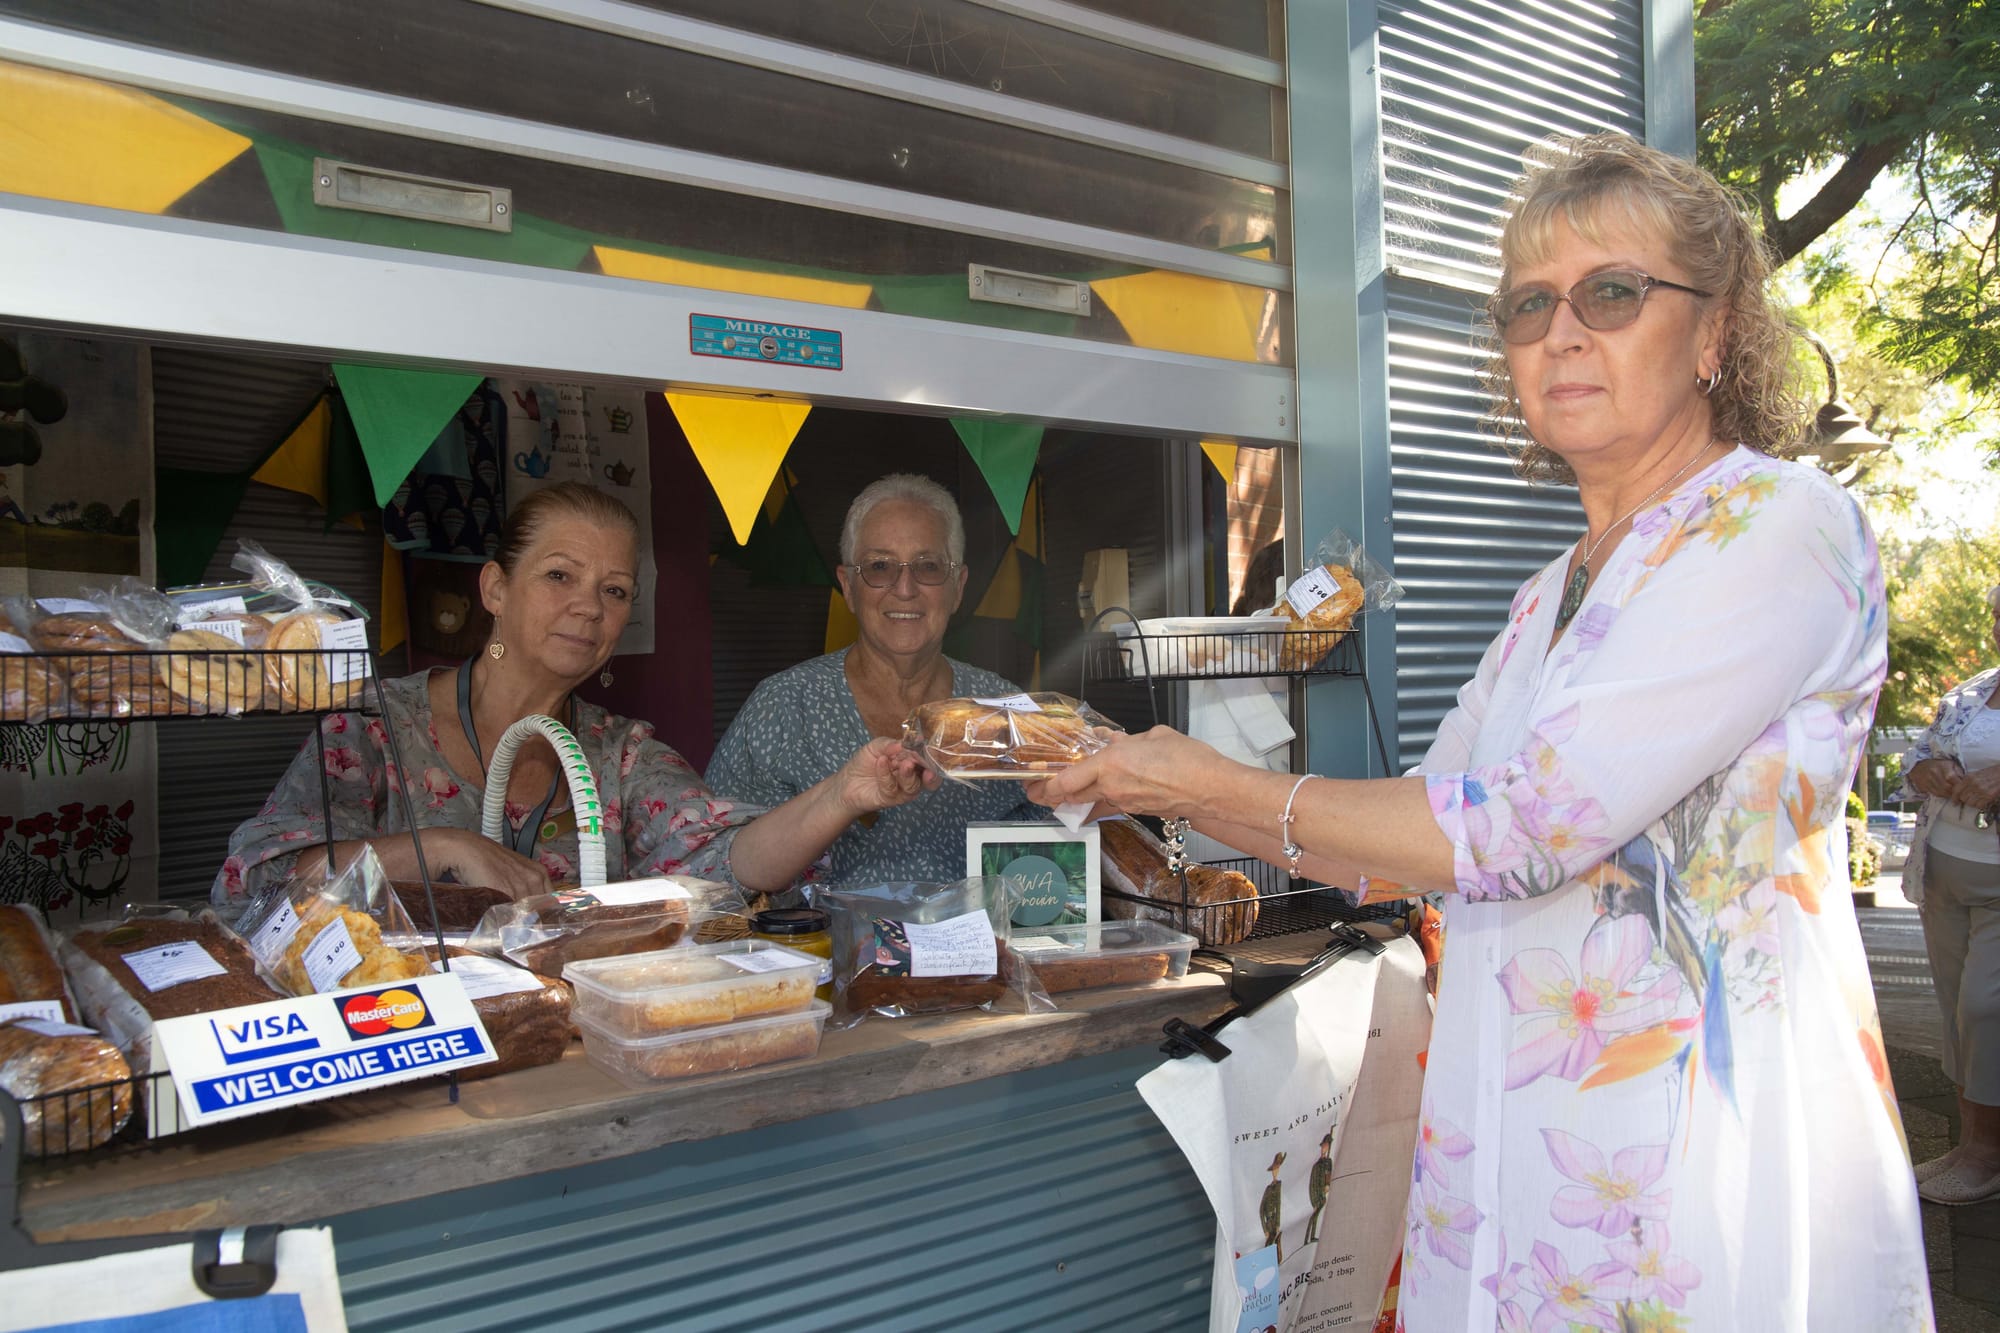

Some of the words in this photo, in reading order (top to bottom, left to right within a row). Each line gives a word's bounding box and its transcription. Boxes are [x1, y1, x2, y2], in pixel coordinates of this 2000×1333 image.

[725, 320, 811, 340] MIRAGE
[1012, 894, 1059, 907] rouin
[226, 1013, 309, 1044] VISA
[347, 1000, 422, 1025] MasterCard
[214, 1053, 385, 1105] WELCOME
[390, 1033, 471, 1070] HERE
[1234, 1127, 1279, 1144] SWEET
[1288, 1114, 1309, 1131] AND
[1314, 1259, 1330, 1271] cup
[1331, 1253, 1355, 1265] desic-
[1328, 1270, 1334, 1279] 2
[1336, 1267, 1355, 1277] tbsp
[1244, 1286, 1257, 1303] red
[1320, 1302, 1353, 1316] coconut
[1327, 1315, 1353, 1327] butter
